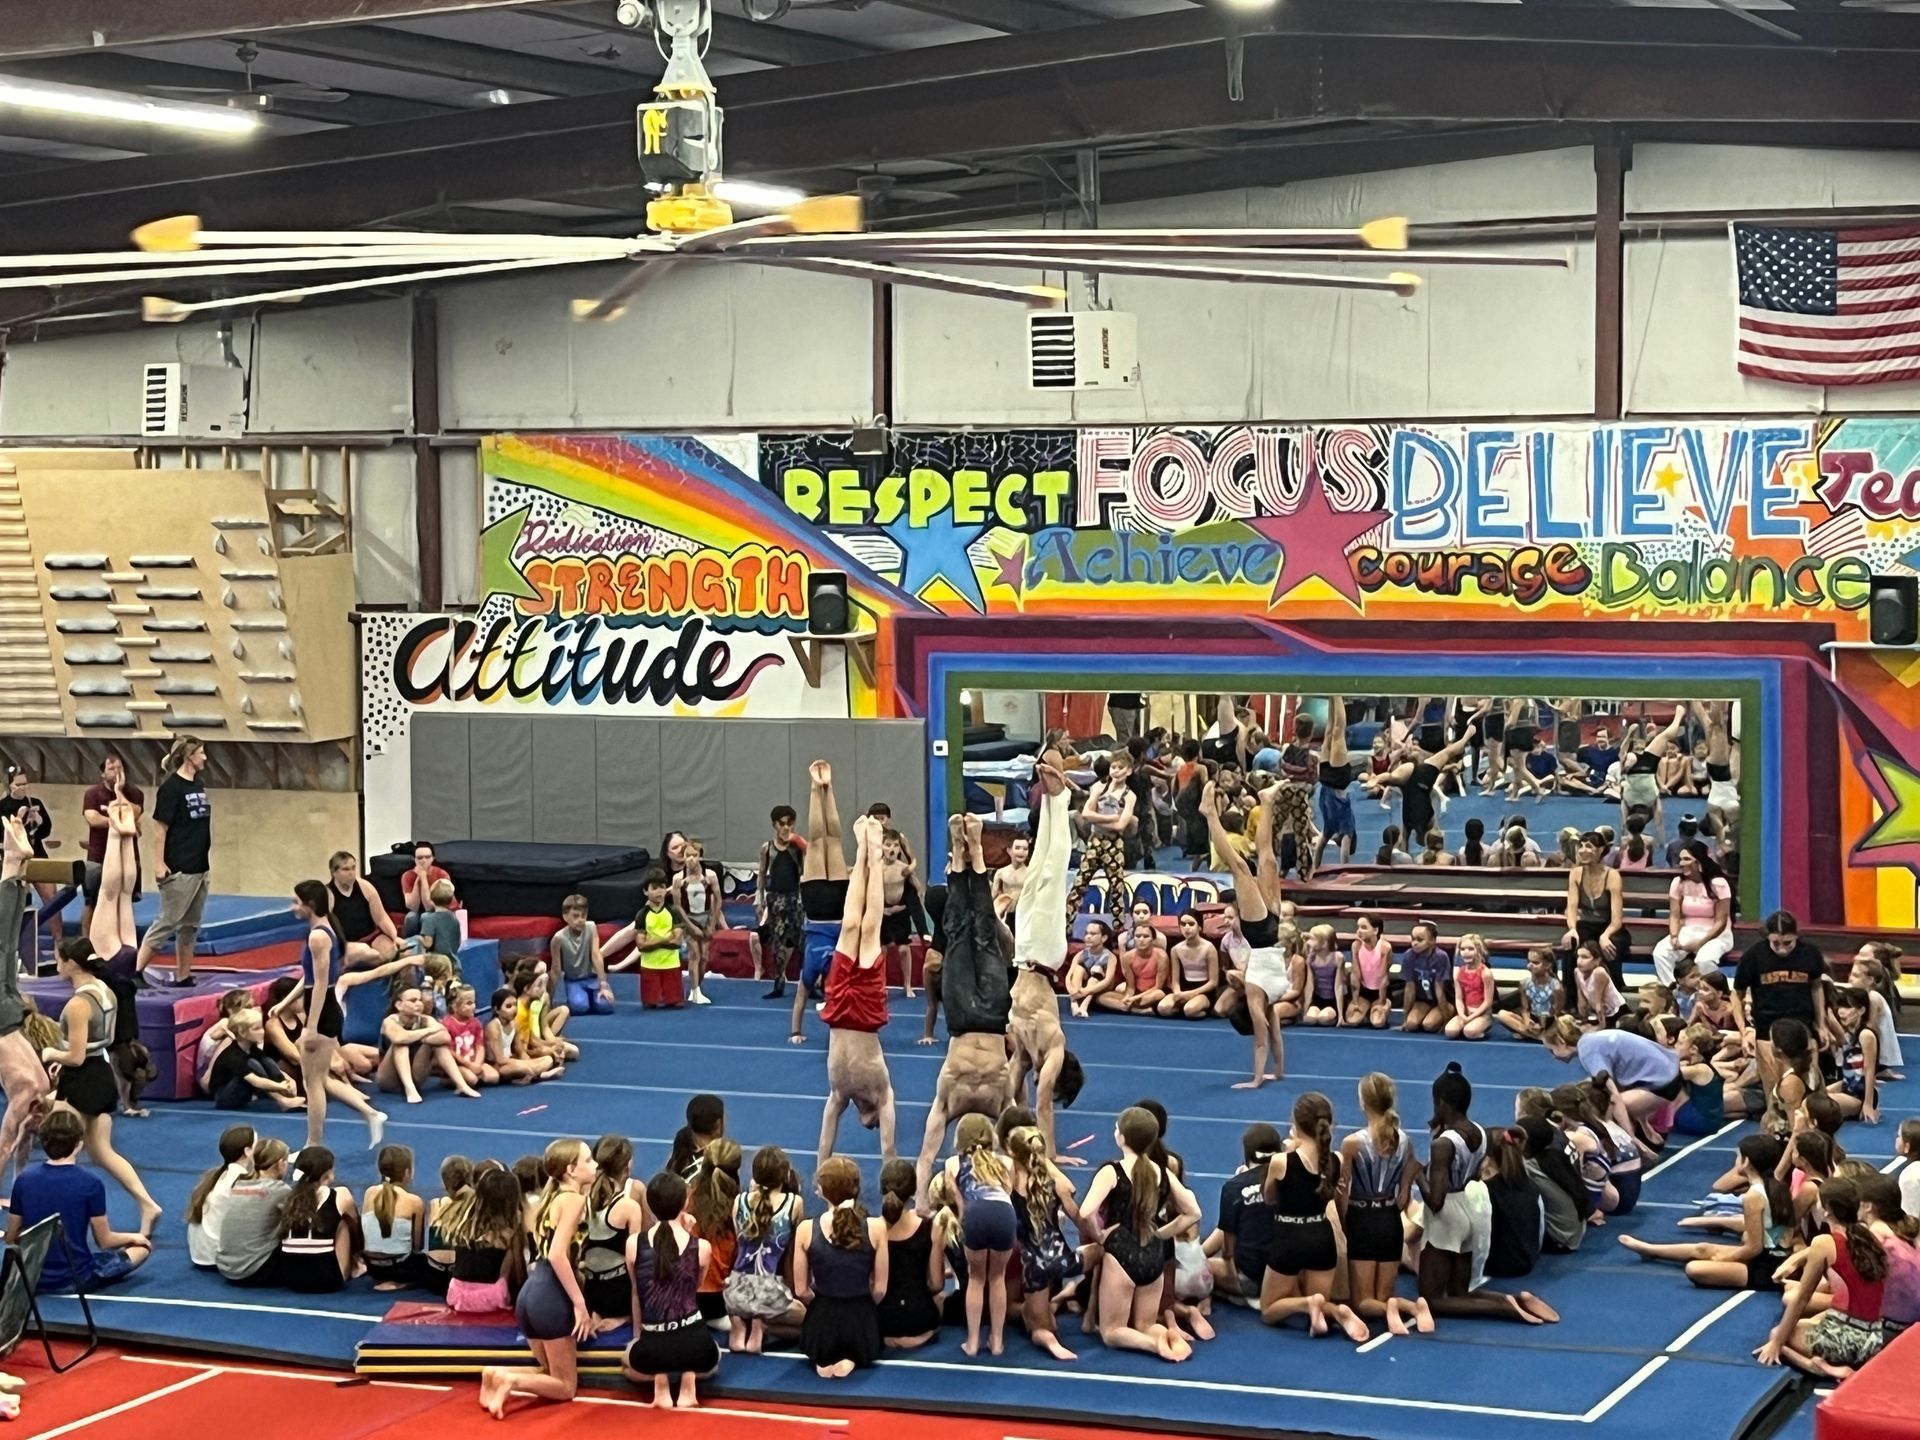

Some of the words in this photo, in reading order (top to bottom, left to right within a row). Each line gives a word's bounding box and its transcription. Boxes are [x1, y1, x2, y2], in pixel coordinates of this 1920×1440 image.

[783, 468, 1070, 528] RESPECT
[1077, 430, 1378, 526] FOCUS
[1393, 428, 1807, 541] BELIEVE
[515, 520, 652, 558] Dedication
[1025, 530, 1282, 590] Achieve
[516, 555, 804, 616] STRENGTH
[1602, 540, 1872, 610] Balance
